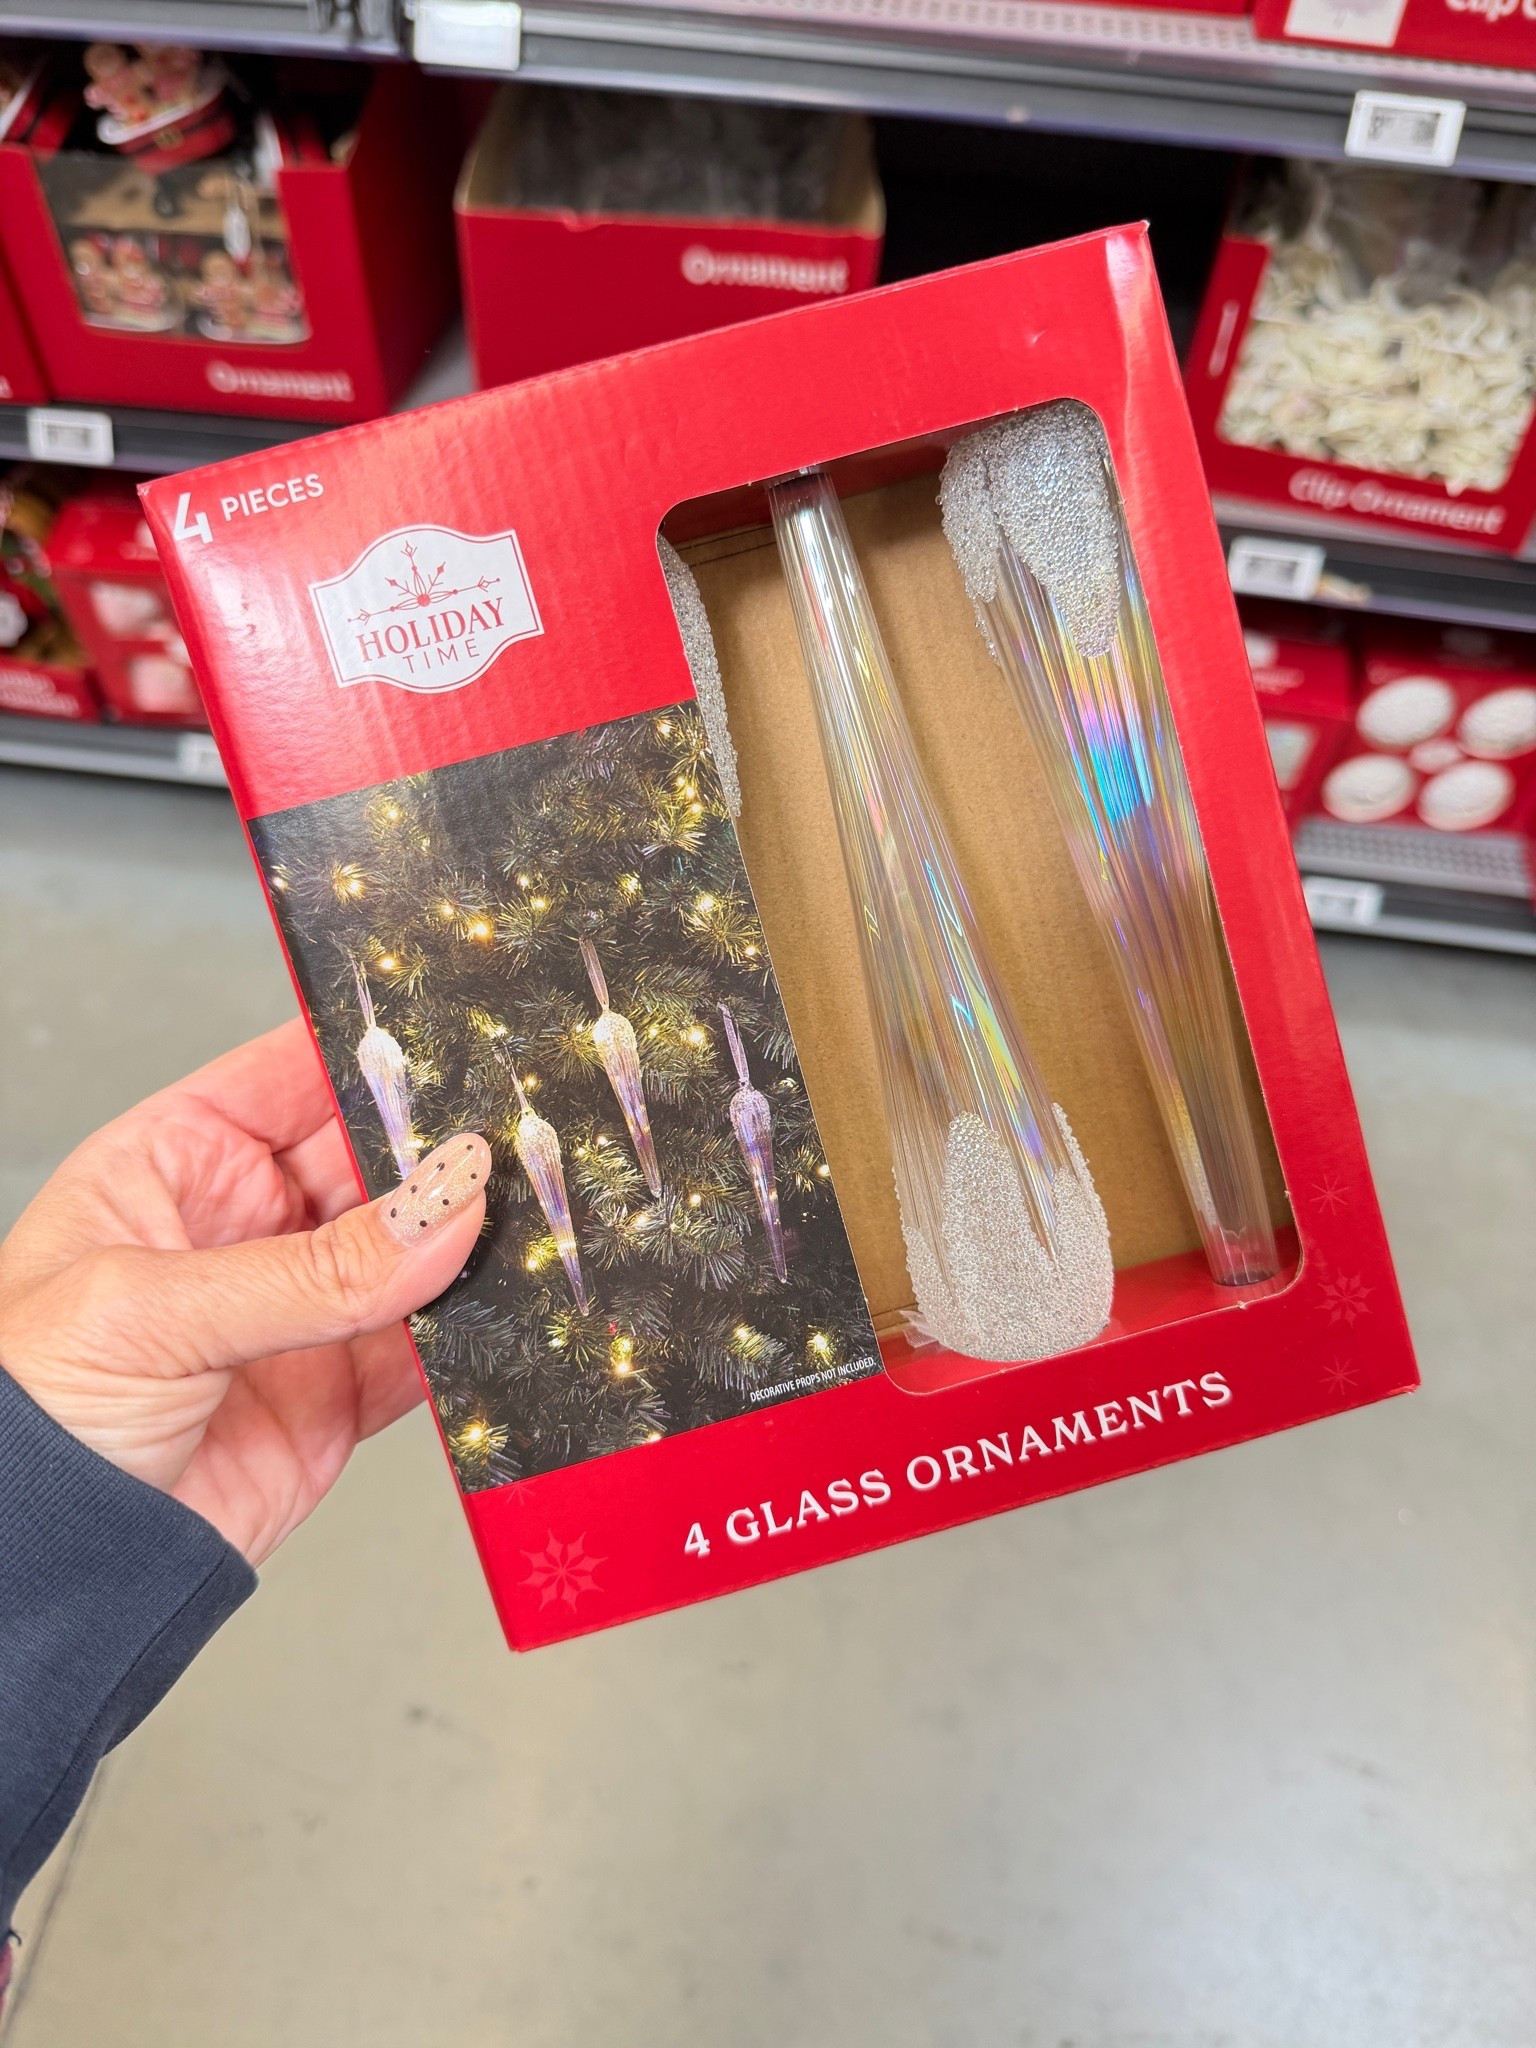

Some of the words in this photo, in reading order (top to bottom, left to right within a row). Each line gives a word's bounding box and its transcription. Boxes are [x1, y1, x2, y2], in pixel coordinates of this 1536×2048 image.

[682, 245, 848, 294] Ornament
[206, 360, 354, 402] Ornament
[173, 491, 214, 544] 4
[221, 473, 325, 521] PIECES
[356, 596, 506, 662] HOLIDAY
[403, 638, 481, 674] TIME
[749, 1380, 796, 1402] DECORATIVE
[795, 1373, 821, 1388] PROPS
[821, 1367, 837, 1381] NOT
[837, 1356, 877, 1375] INCLUDED.
[684, 1522, 711, 1557] 4
[725, 1468, 892, 1545] GLASS
[906, 1370, 1233, 1491] ORNAMENTS
